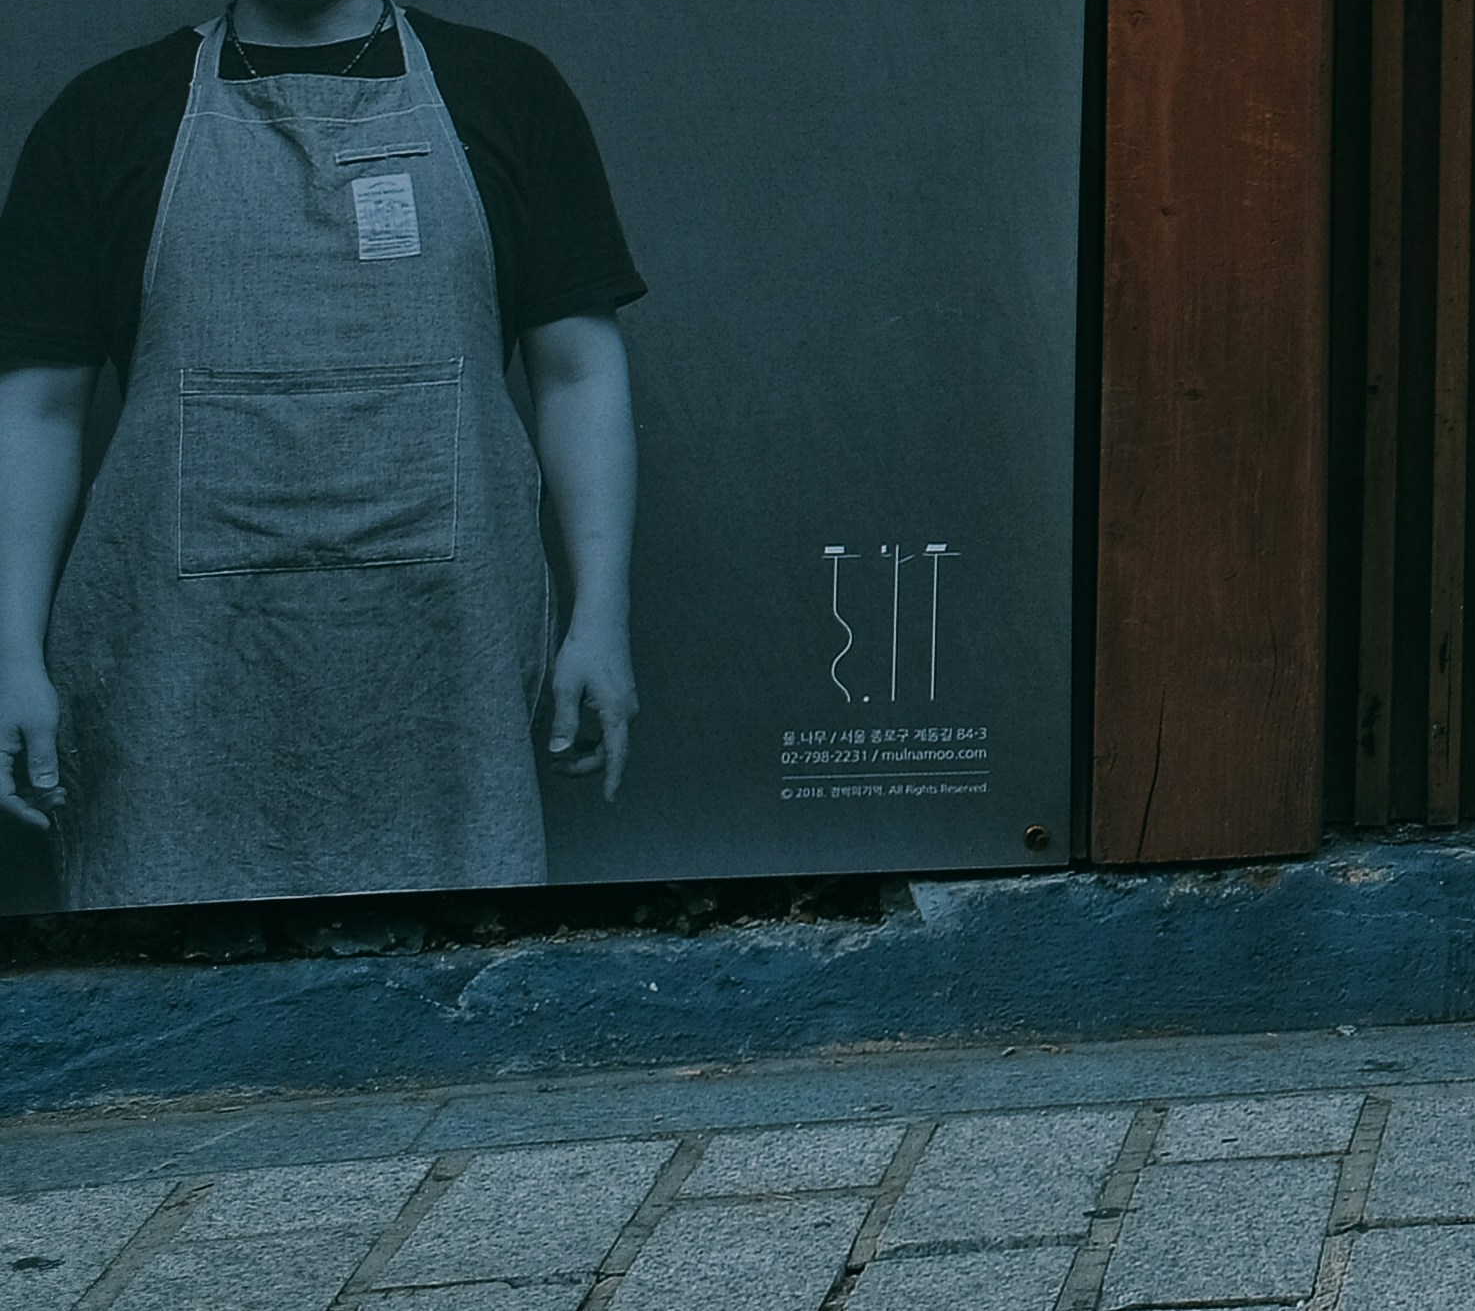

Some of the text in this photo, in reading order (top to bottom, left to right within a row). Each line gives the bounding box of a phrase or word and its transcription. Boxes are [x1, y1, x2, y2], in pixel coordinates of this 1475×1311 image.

[840, 729, 866, 744] 서울
[956, 727, 988, 741] 84-3
[781, 749, 868, 765] 02-798-2231
[881, 746, 987, 762] mulnamoo.com
